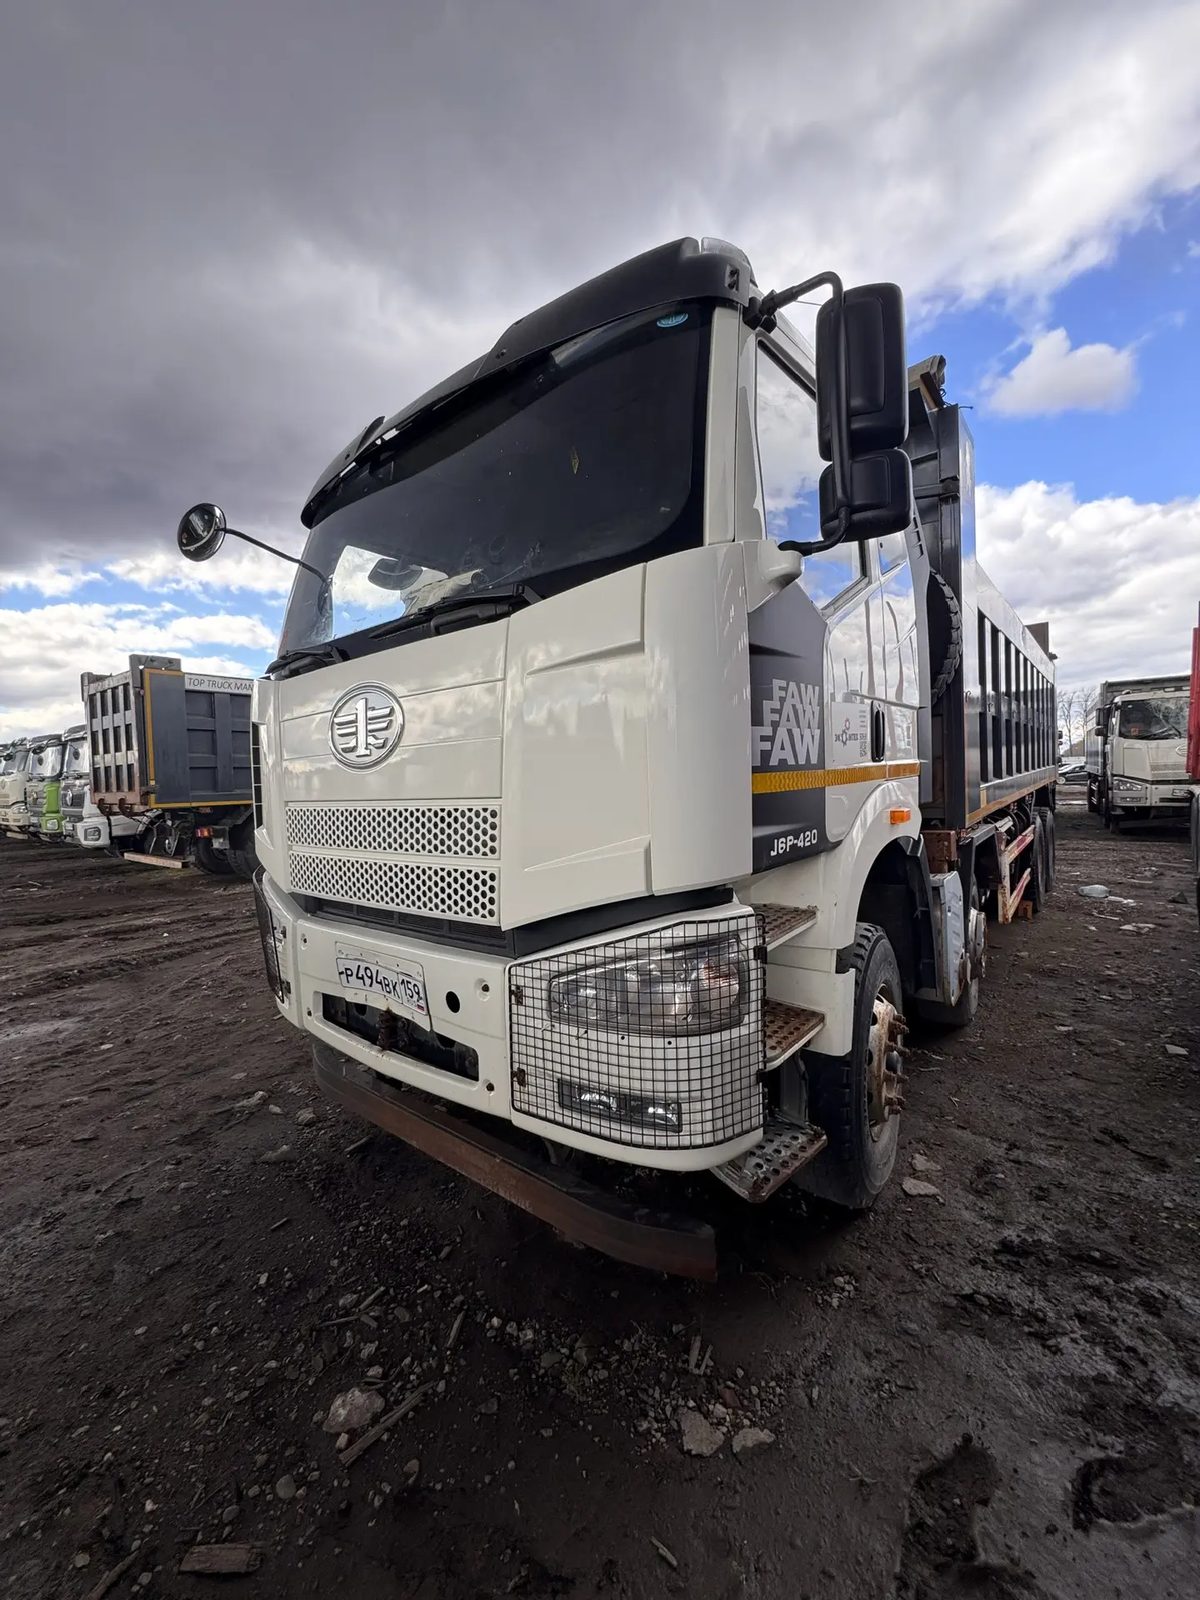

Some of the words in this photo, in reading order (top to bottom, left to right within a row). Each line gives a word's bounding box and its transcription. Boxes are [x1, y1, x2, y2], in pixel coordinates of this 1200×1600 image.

[188, 677, 205, 687] TOP
[207, 679, 233, 690] TRUCK
[772, 678, 820, 708] FAW
[763, 700, 820, 734] FAW
[751, 726, 821, 766] FAW
[770, 829, 818, 857] J6P-420
[400, 978, 422, 1003] 159
